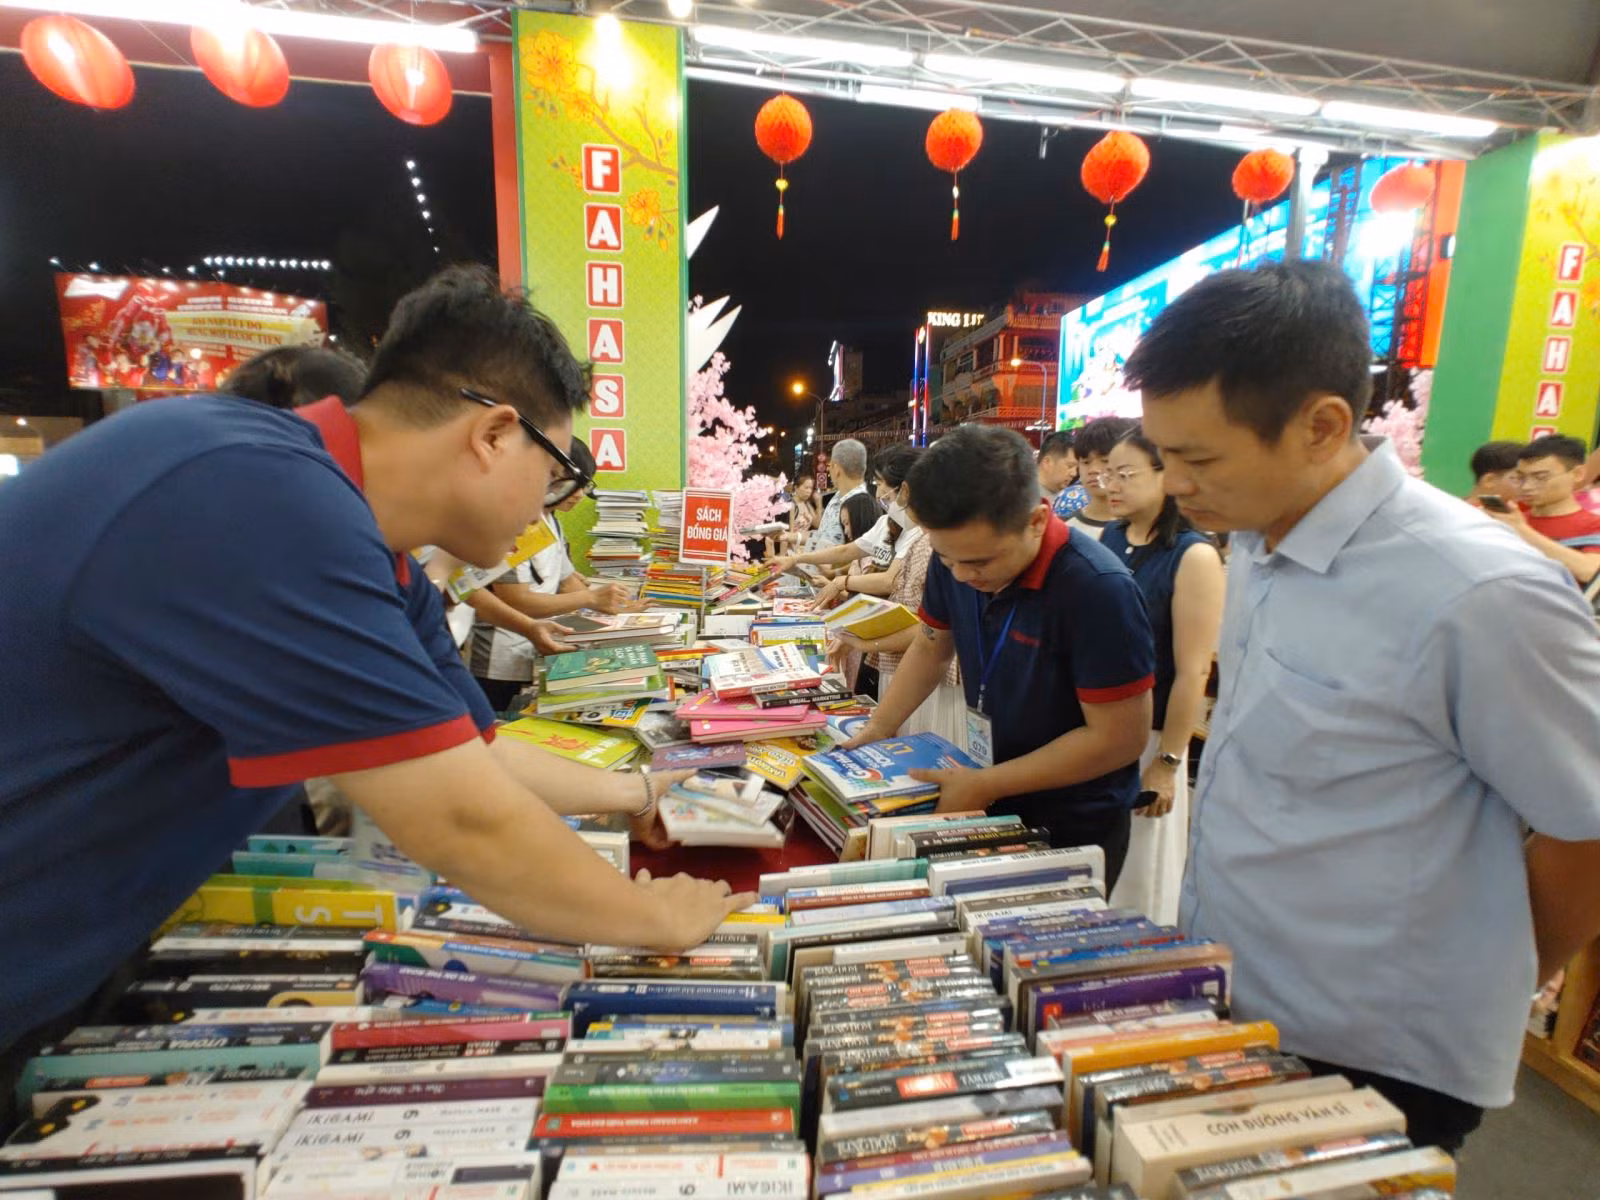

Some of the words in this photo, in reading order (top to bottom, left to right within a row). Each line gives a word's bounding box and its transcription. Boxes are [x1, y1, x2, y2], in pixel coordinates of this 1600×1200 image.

[589, 149, 624, 468] FAHASA
[927, 312, 961, 327] KING
[696, 505, 722, 523] SÁCH
[713, 525, 728, 541] GIÁ
[1207, 1119, 1240, 1137] CON
